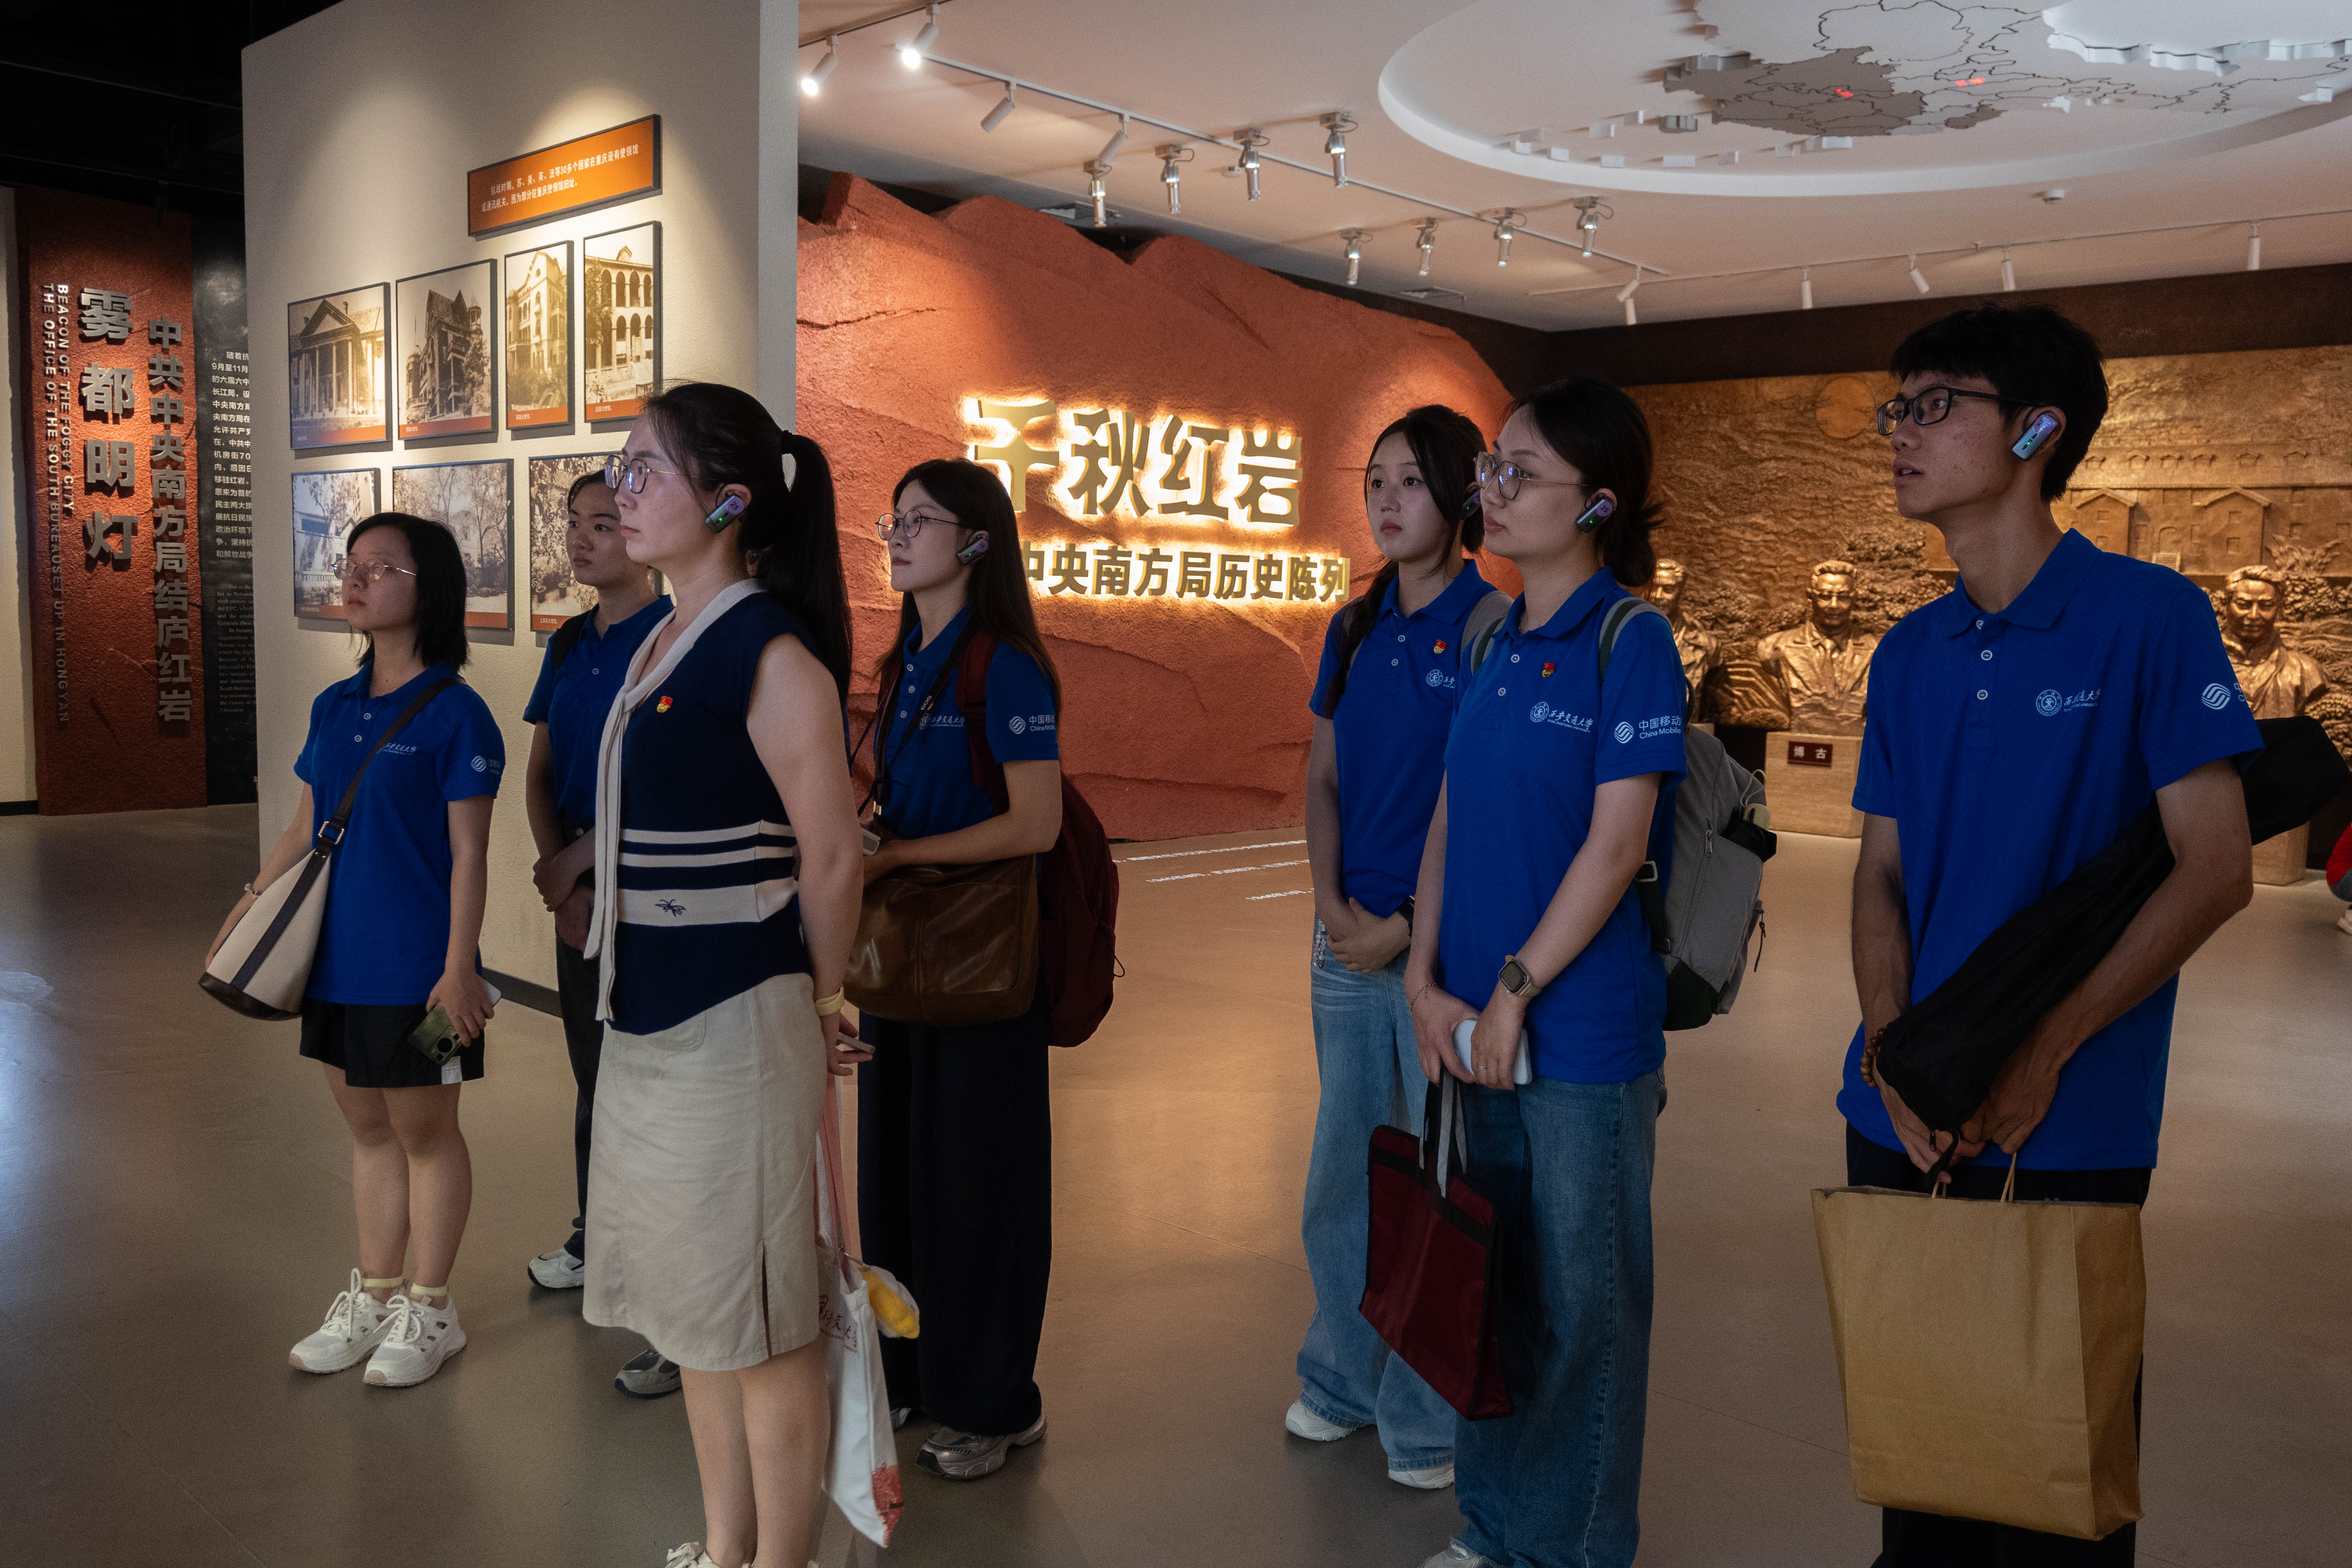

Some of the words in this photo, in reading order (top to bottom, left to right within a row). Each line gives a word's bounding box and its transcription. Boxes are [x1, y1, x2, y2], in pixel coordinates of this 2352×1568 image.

[44, 283, 54, 312] THE
[57, 284, 69, 348] BEACON
[44, 320, 56, 375] OFFICE
[226, 351, 249, 360] 随着抗
[59, 354, 70, 373] OF
[212, 362, 248, 373] 9月至11月
[212, 375, 249, 386] 的六届六中
[46, 381, 57, 400] OF
[60, 381, 71, 410] THE
[212, 388, 250, 398] 长江局，设
[47, 408, 58, 437] THE
[81, 287, 139, 560] 雾都明灯
[213, 413, 250, 423] 央南方局在
[62, 417, 73, 468] FOGGY
[213, 438, 250, 448] 在，中共中
[214, 450, 250, 460] 机房街70
[974, 398, 1303, 526] 千秋红岩
[48, 444, 60, 496] SOUTH
[214, 475, 249, 485] 移驻红岩。
[64, 475, 74, 510] CITY
[215, 488, 252, 497] 恩来为首的
[730, 501, 740, 510] 25
[1601, 505, 1610, 513] 25
[149, 316, 193, 721] 中共中央南方局结庐红岩
[215, 513, 252, 521] 展抗日民族
[215, 525, 253, 534] 政治环境下
[54, 601, 64, 619] UP
[56, 627, 65, 641] IN
[56, 648, 69, 721] HONGYAN
[920, 695, 932, 710] EOS
[1639, 715, 1681, 731] 中国移动
[1639, 731, 1658, 739] China
[1659, 727, 1681, 735] Mobile
